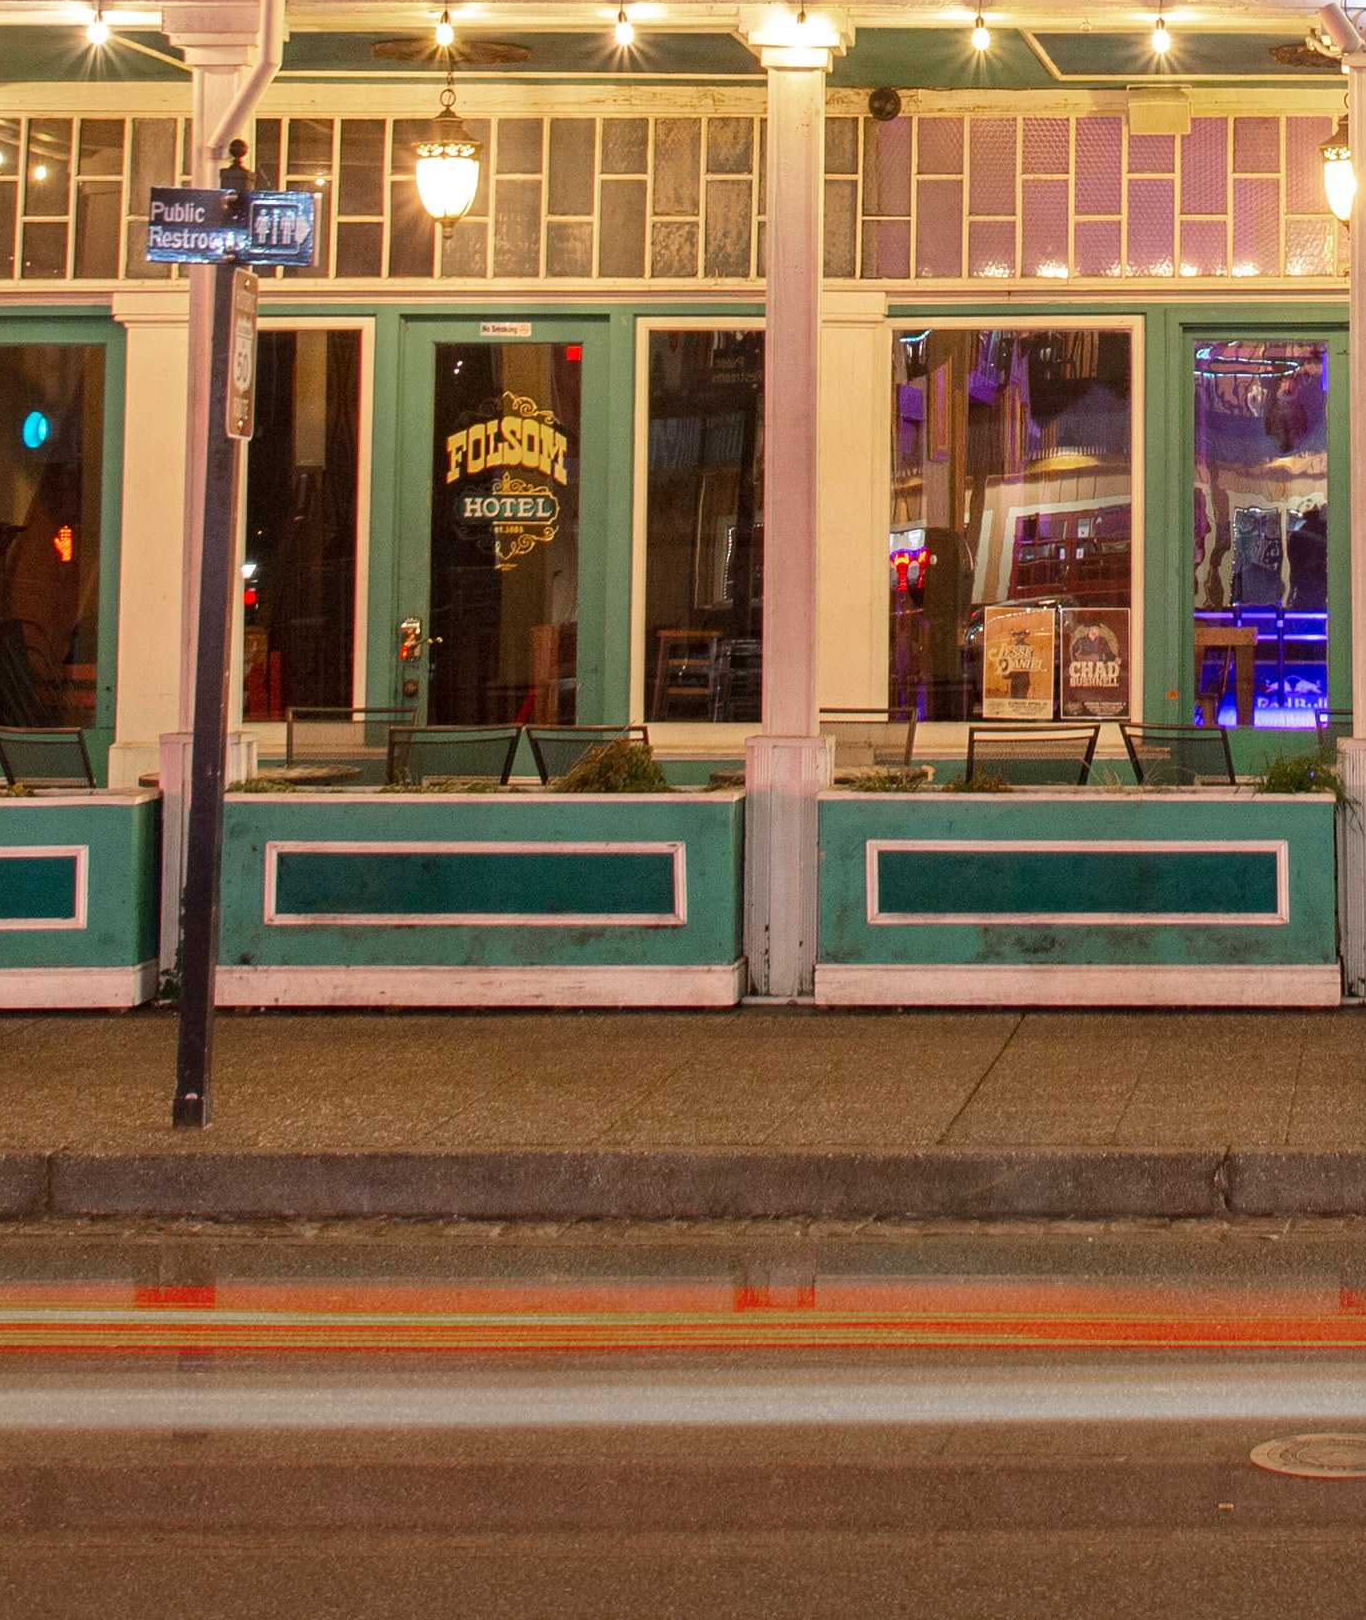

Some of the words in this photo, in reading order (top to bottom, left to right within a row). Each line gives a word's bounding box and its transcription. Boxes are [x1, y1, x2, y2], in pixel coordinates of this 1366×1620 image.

[150, 202, 205, 223] Public
[446, 416, 567, 486] FOLSOM
[464, 497, 552, 518] HOTEL
[1069, 661, 1120, 678] CHAD
